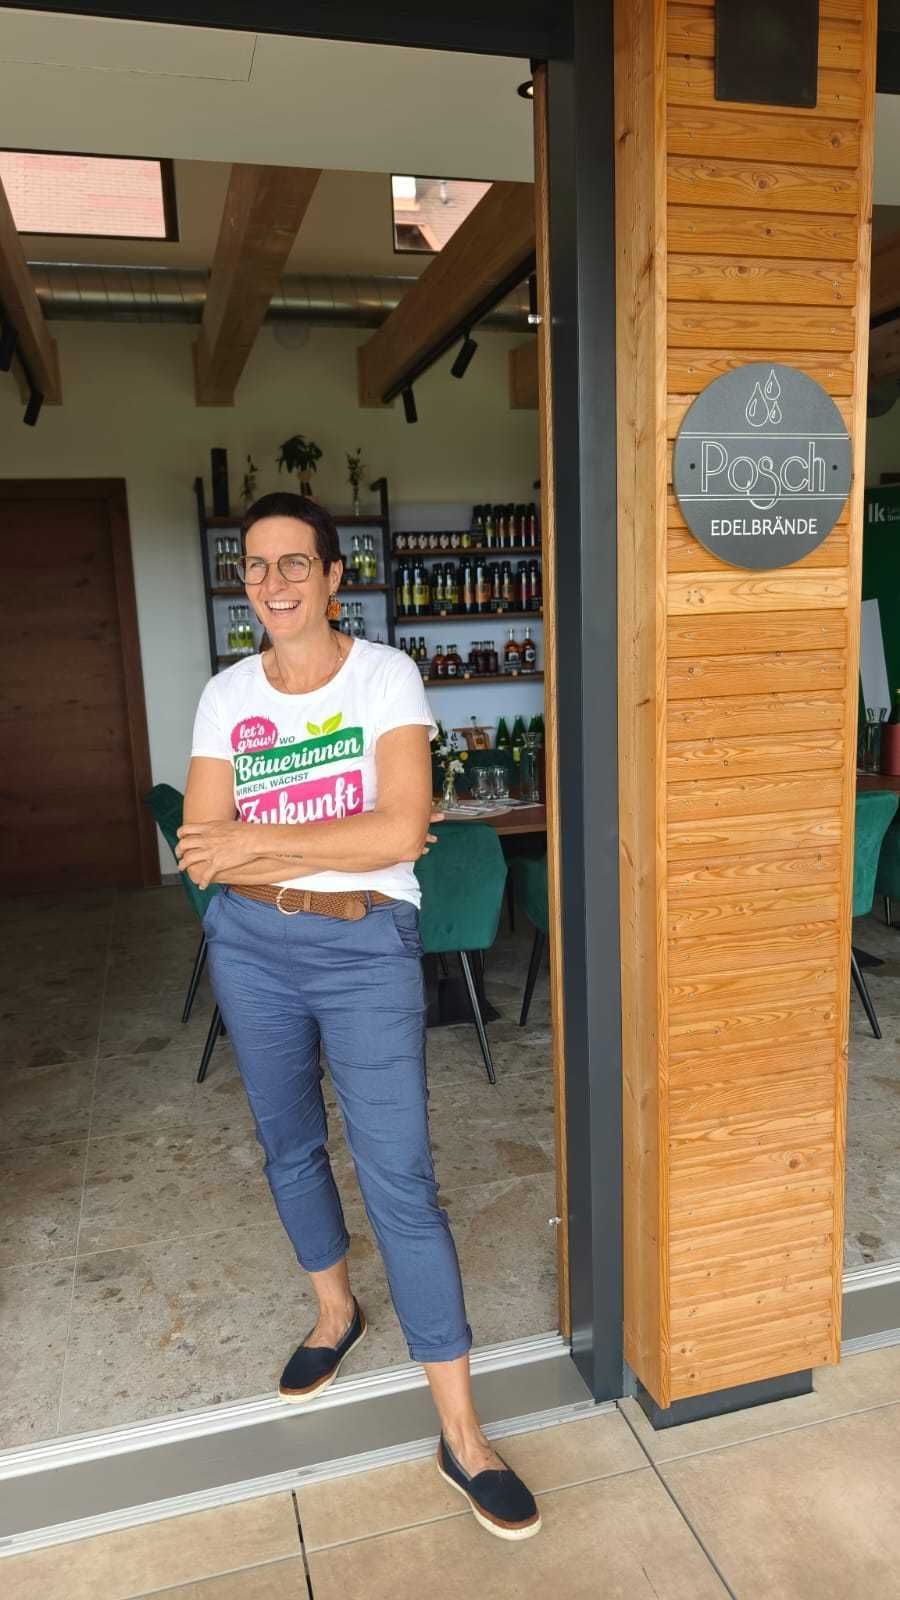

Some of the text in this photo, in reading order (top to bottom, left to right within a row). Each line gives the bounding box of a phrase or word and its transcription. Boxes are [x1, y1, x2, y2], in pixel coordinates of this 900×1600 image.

[701, 441, 826, 510] Posch
[711, 516, 818, 536] EDELBRÄNDE
[237, 730, 276, 753] grow!
[239, 723, 265, 739] let's
[236, 737, 360, 781] Bäuerinnen
[270, 772, 309, 788] WÄCHST
[240, 777, 360, 825] Zukunft
